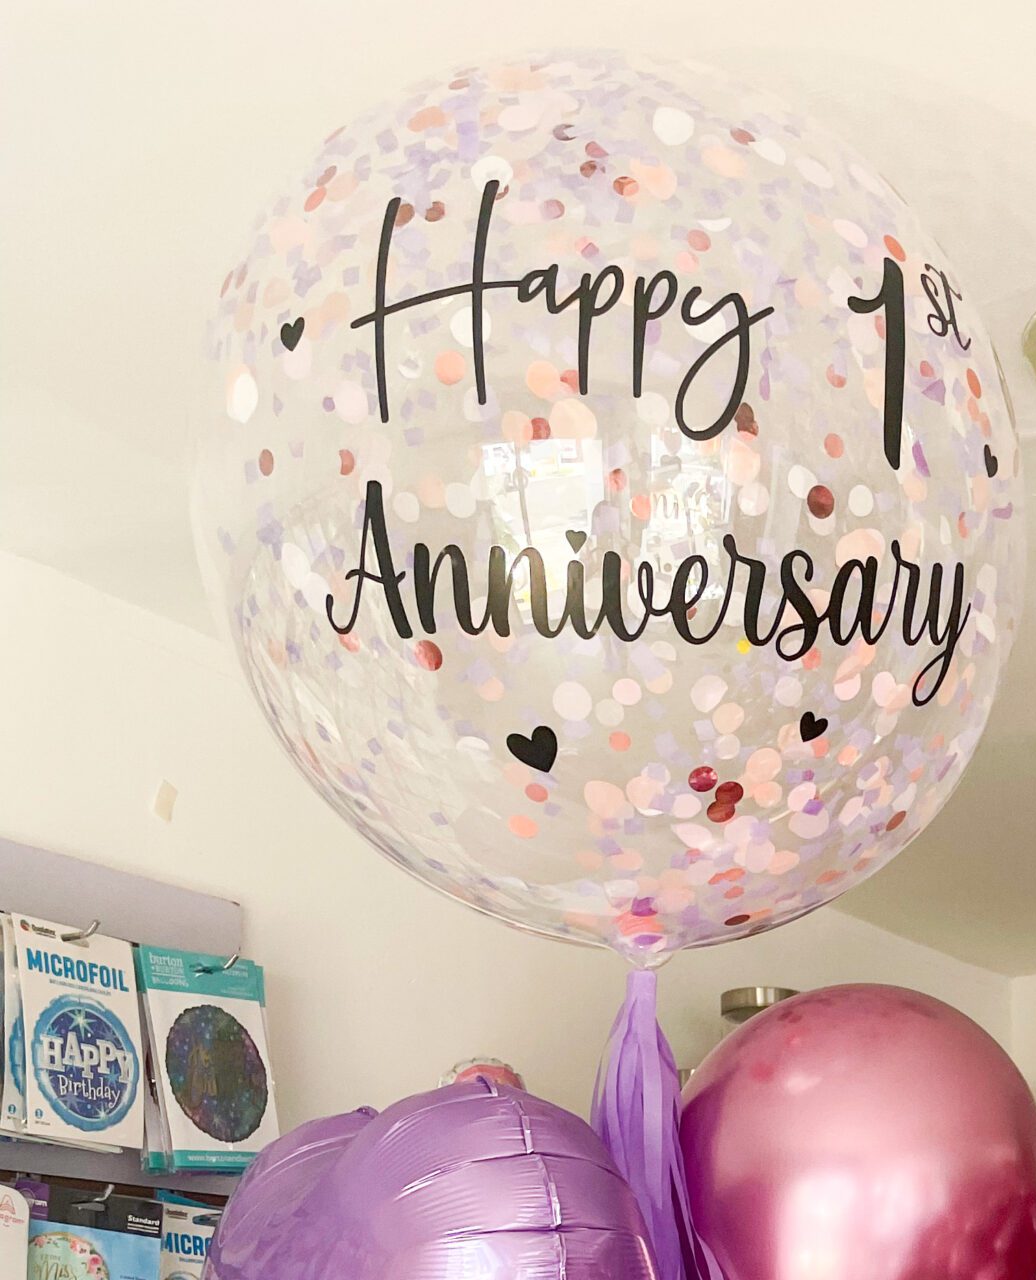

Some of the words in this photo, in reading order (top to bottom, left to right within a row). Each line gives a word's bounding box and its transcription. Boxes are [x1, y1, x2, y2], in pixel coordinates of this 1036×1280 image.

[351, 180, 774, 441] Happy
[847, 257, 972, 471] 1st
[326, 480, 971, 707] Anniversary
[26, 947, 130, 993] MICROFOIL
[40, 1031, 134, 1084] HAPPY
[57, 1074, 121, 1109] Birthday
[127, 1214, 160, 1226] Standard
